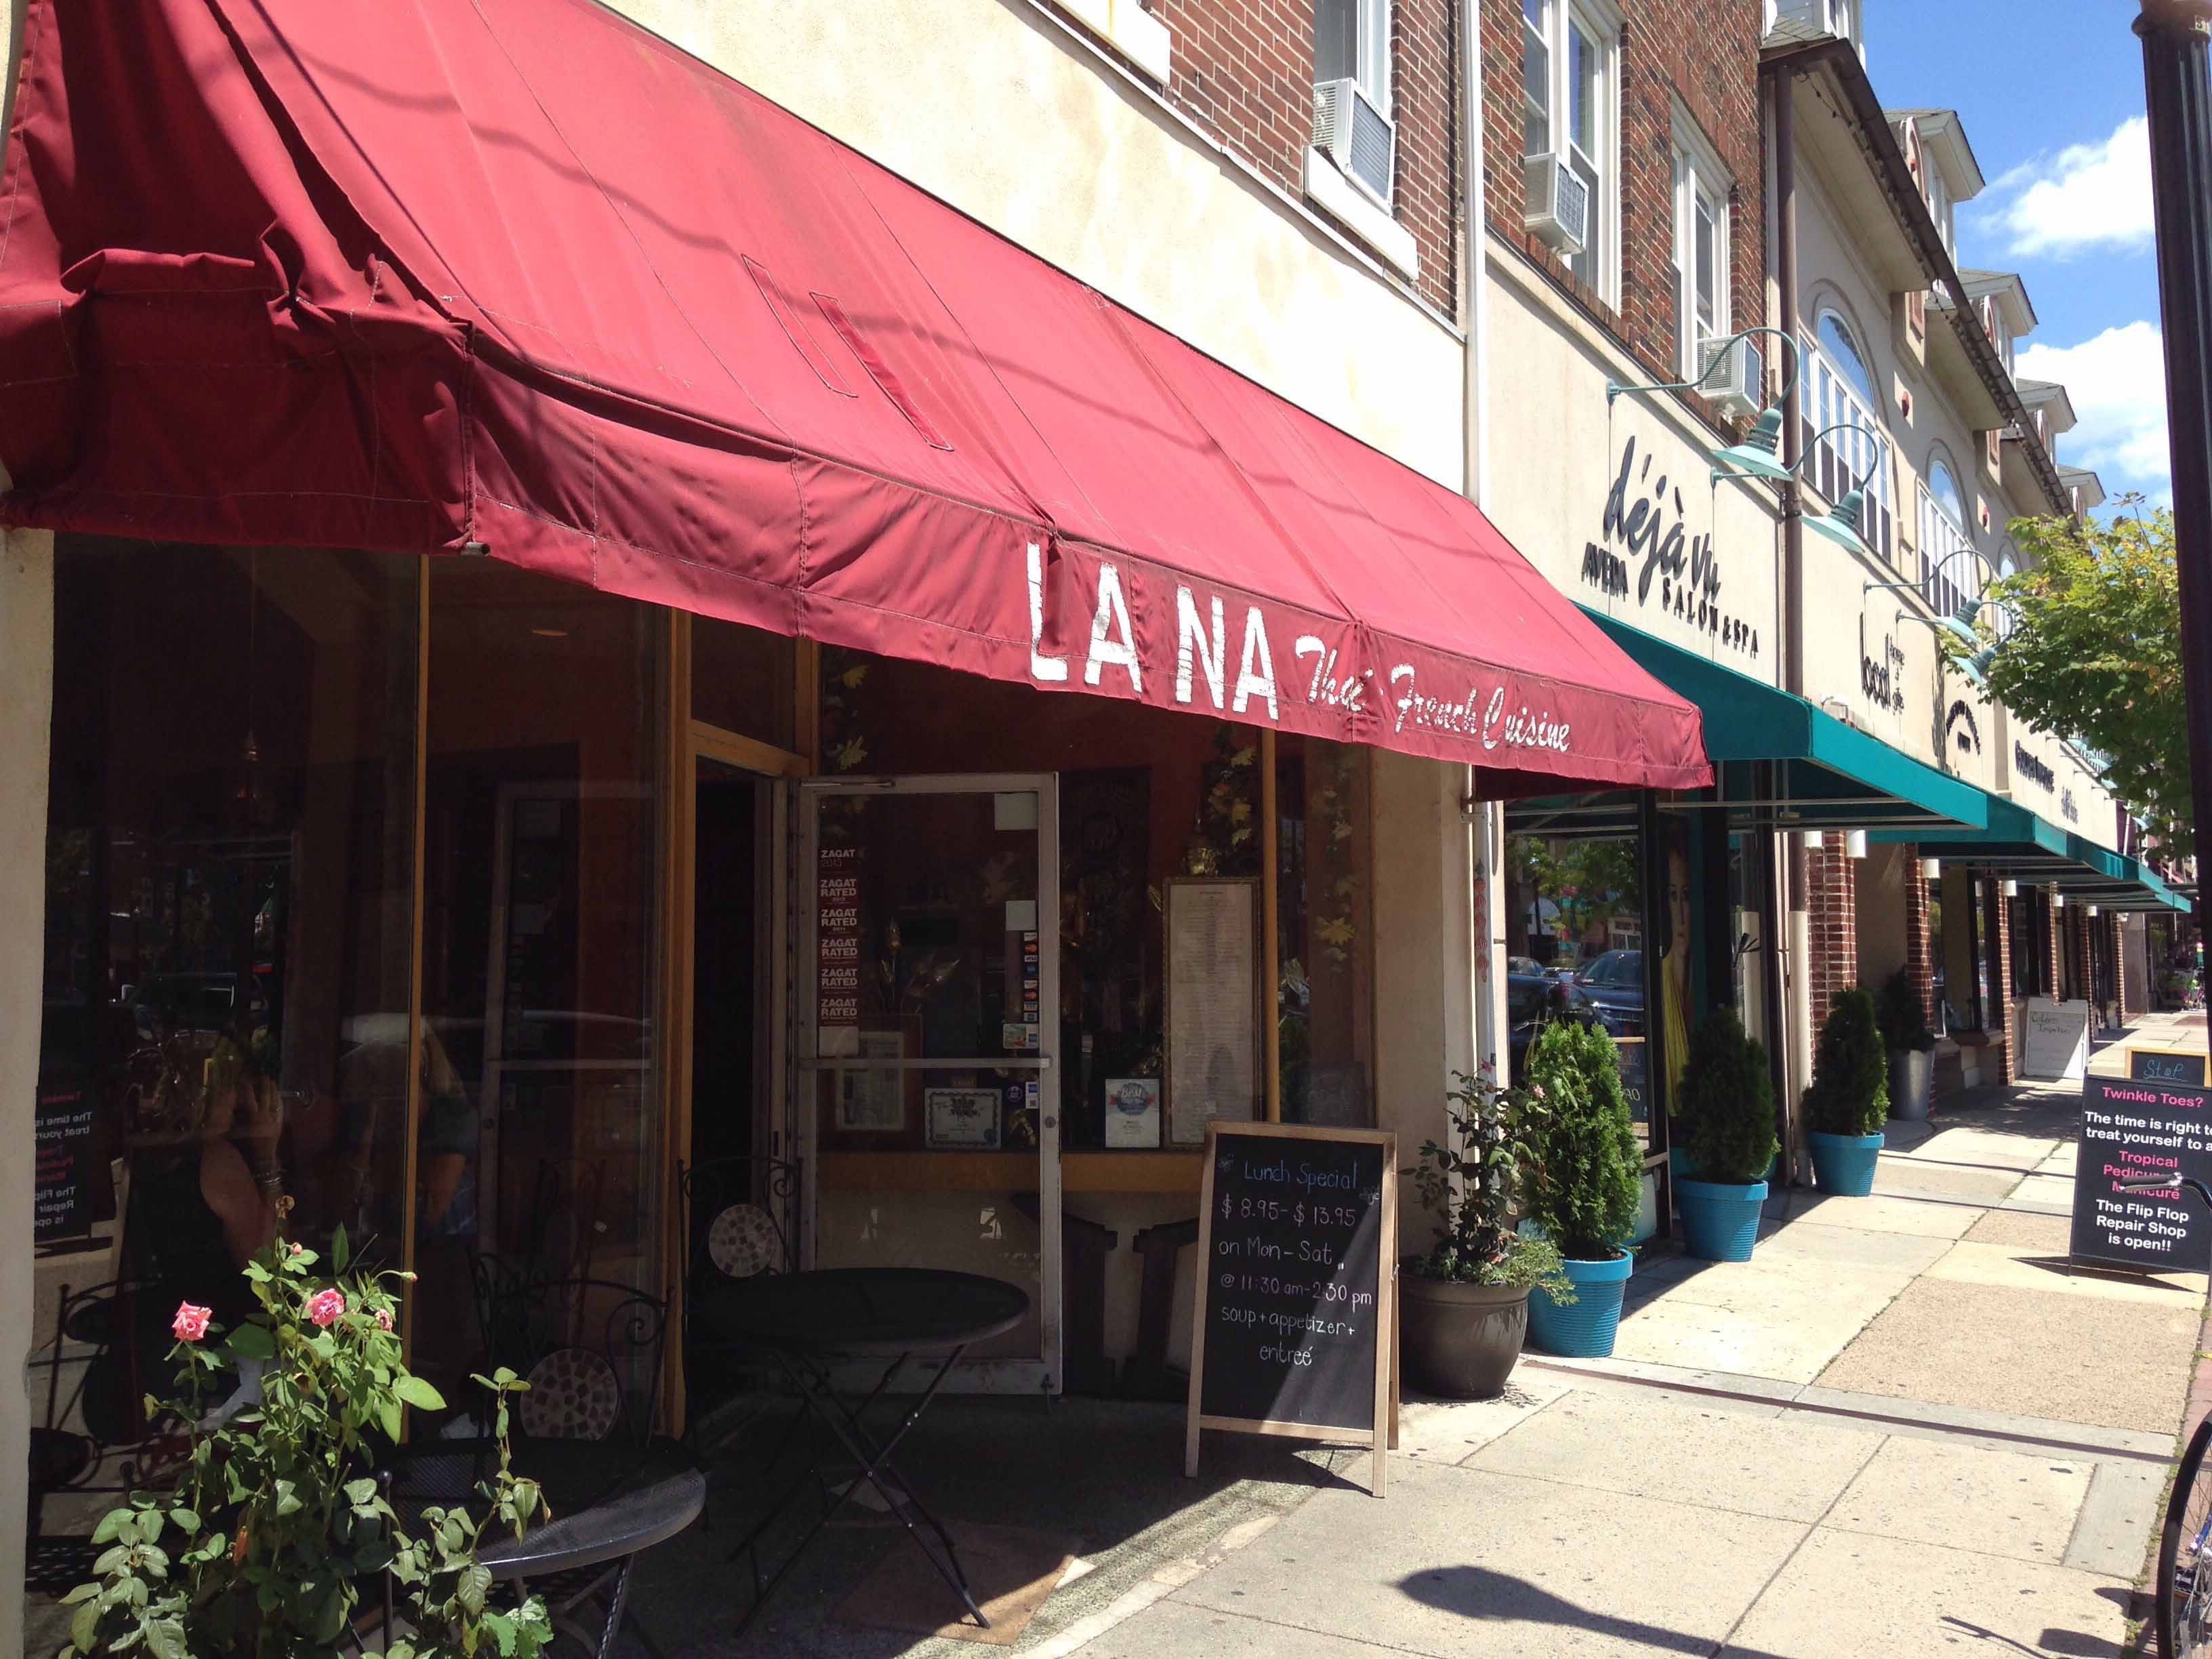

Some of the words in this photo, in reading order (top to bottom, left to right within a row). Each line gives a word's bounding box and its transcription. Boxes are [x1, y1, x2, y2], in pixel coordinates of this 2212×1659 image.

[1581, 542, 1629, 602] AVEDA
[1662, 577, 1718, 637] SALON
[1734, 619, 1758, 659] SPA
[1027, 542, 1141, 692] LA
[1176, 585, 1279, 720] NA
[1483, 687, 1570, 752] Cuisine
[821, 849, 856, 858] ZAGAT
[820, 879, 857, 888] ZAGAT
[821, 888, 857, 897] RATED
[821, 908, 857, 917] ZAGAT
[821, 918, 857, 926] RATED
[821, 939, 857, 947] ZAGAT
[821, 948, 857, 957] RATED
[821, 968, 857, 977] ZAGAT
[821, 977, 857, 987] RATED
[821, 998, 857, 1008] ZAGAT
[821, 1008, 857, 1017] RATED
[2102, 1087, 2156, 1103] Twinkle
[2160, 1092, 2204, 1108] Toes?
[2085, 1111, 2111, 1124] The
[2114, 1114, 2146, 1128] time
[2149, 1118, 2162, 1130] is
[2165, 1120, 2201, 1135] right
[2085, 1126, 2121, 1141] treat
[2123, 1134, 2184, 1149] yourself
[2187, 1138, 2202, 1150] to
[2119, 1150, 2178, 1168] Tropical
[1244, 1160, 1290, 1182] Lunch
[1296, 1162, 1357, 1193] Special
[2096, 1199, 2123, 1213] The
[2127, 1203, 2153, 1218] Flip
[2157, 1207, 2189, 1223] Flop
[2096, 1215, 2145, 1231] Repair
[2148, 1222, 2186, 1240] Shop
[1219, 1241, 1240, 1254] on
[2108, 1233, 2121, 1244] is
[2124, 1237, 2171, 1252] open!!
[1352, 1292, 1372, 1313] pm
